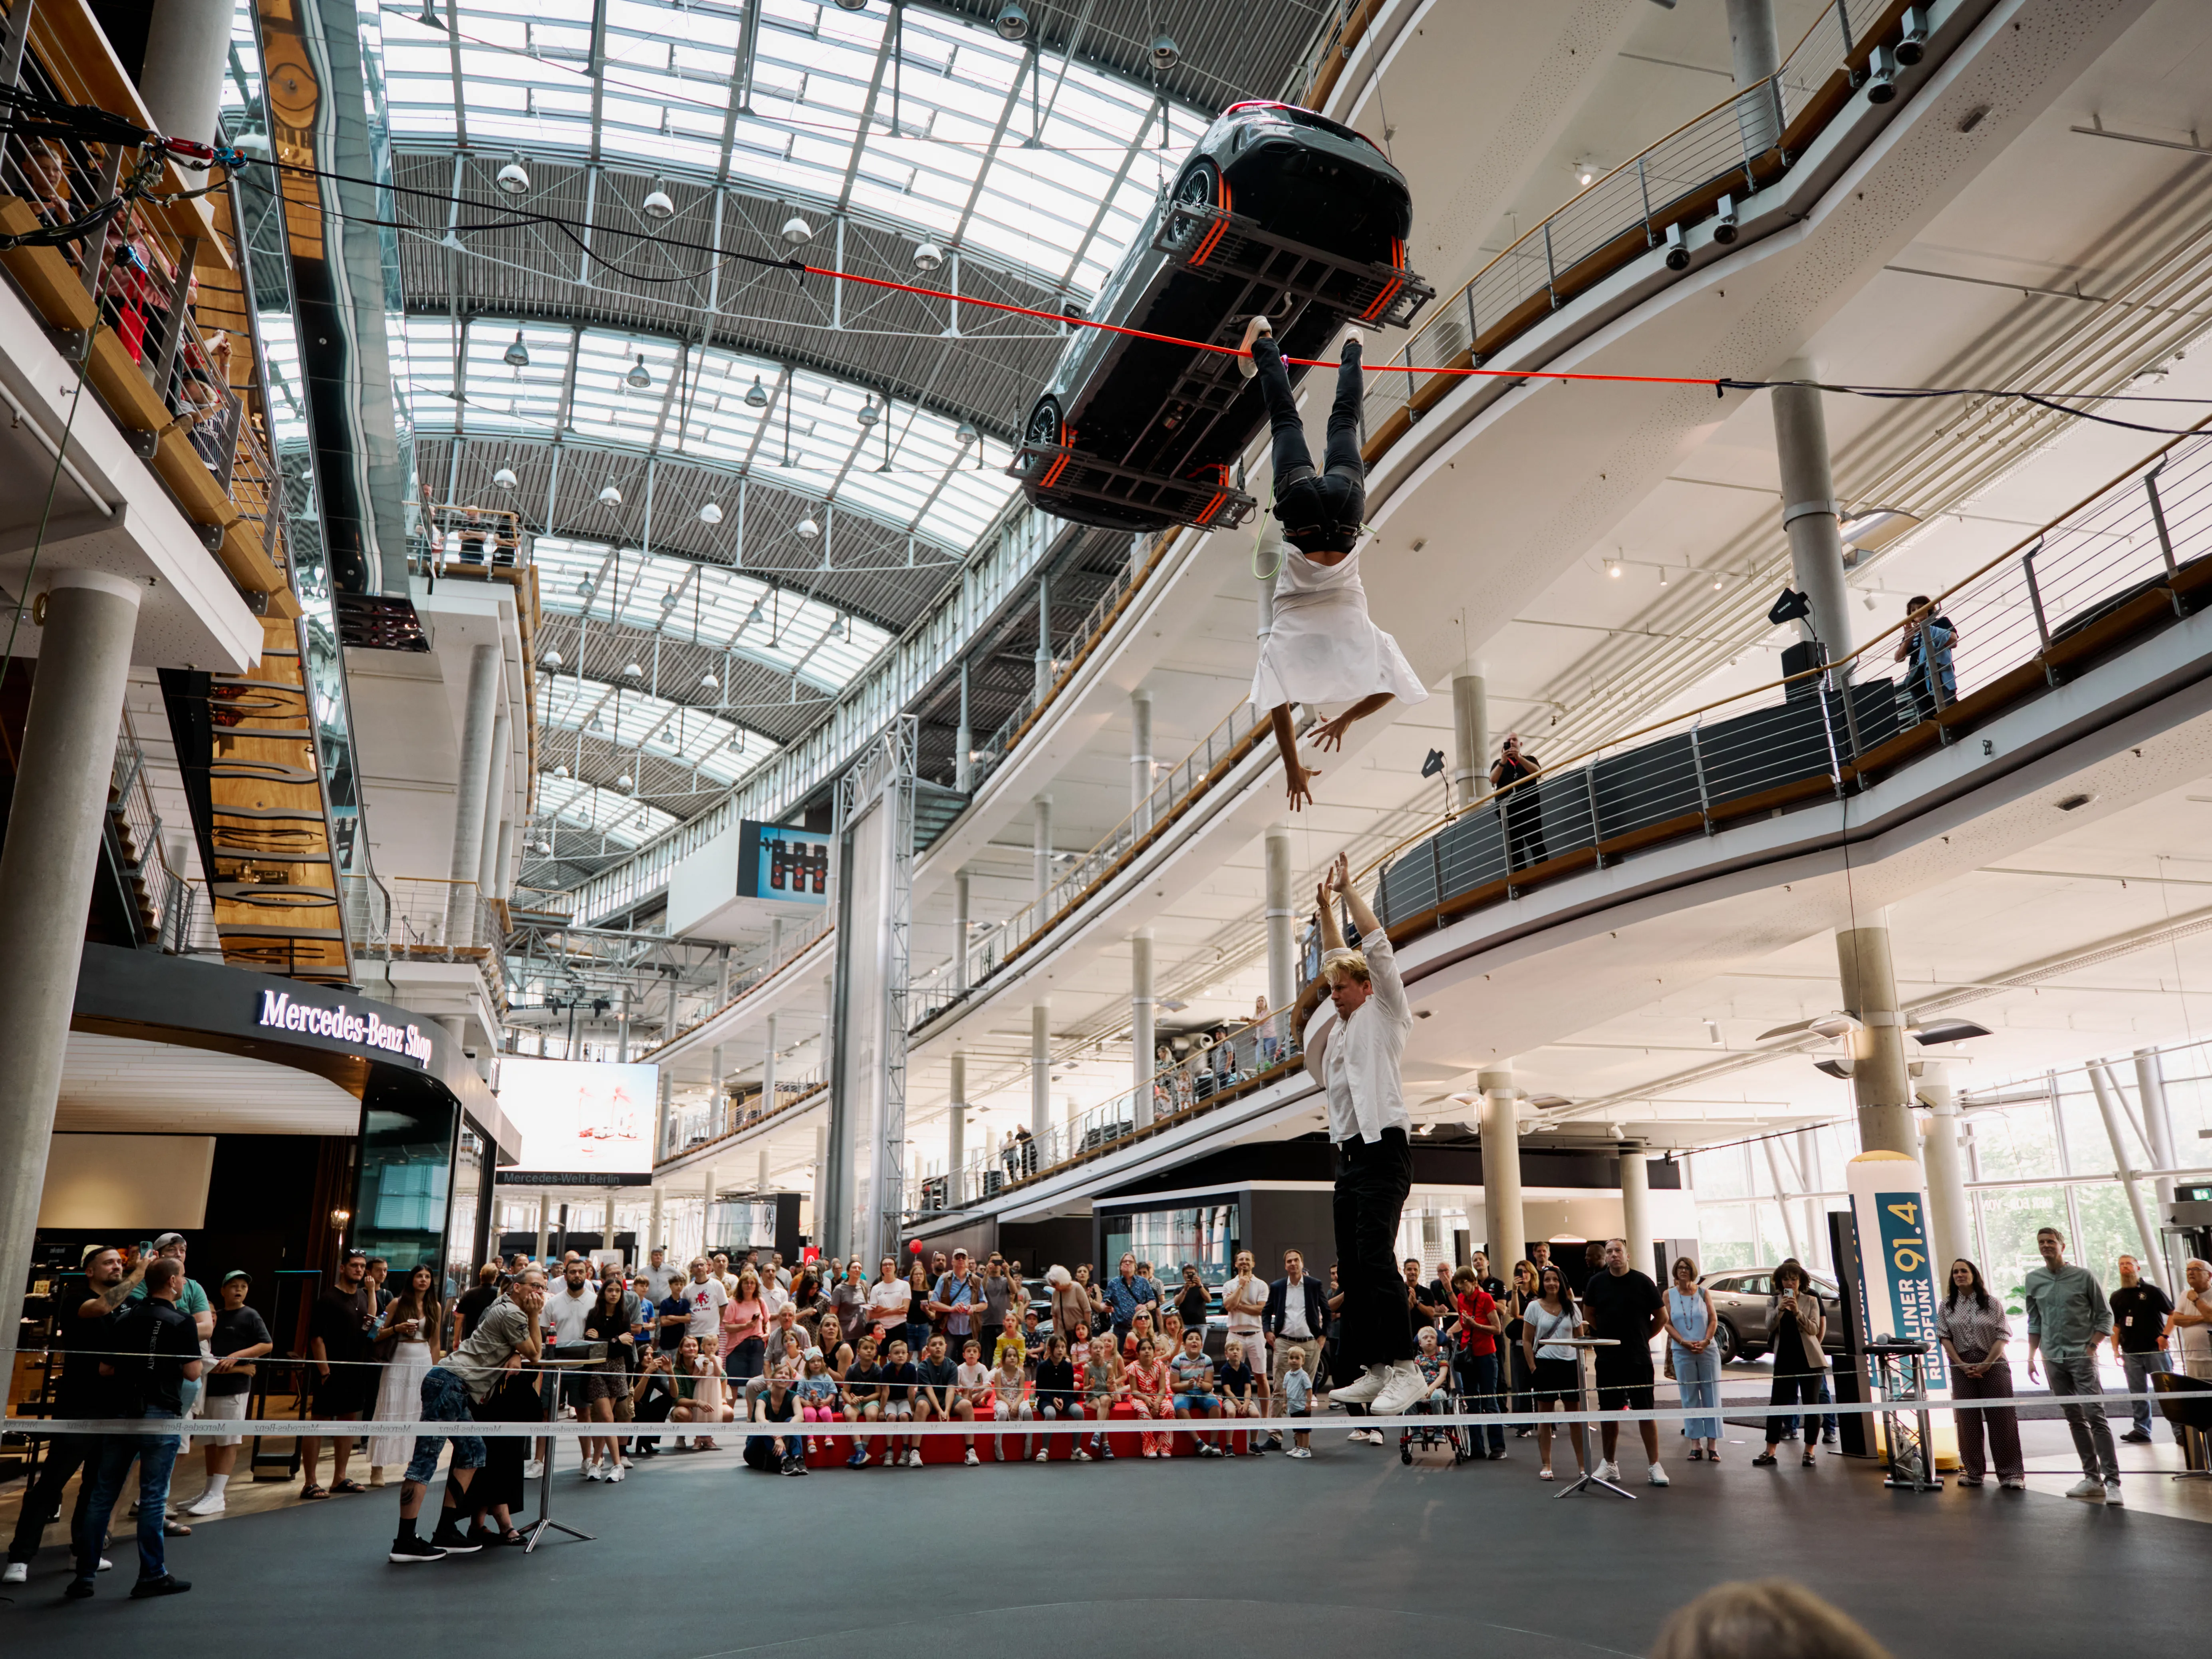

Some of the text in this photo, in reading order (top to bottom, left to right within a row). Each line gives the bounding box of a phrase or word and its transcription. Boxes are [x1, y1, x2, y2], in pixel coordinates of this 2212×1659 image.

[260, 990, 431, 1069] Mercedes-Benz Shop
[504, 1172, 620, 1184] Mercedes-Welt Berlin
[1888, 1202, 1925, 1272] 91.4
[1898, 1279, 1928, 1380] LINER
[1916, 1278, 1942, 1380] RUNDFUNK
